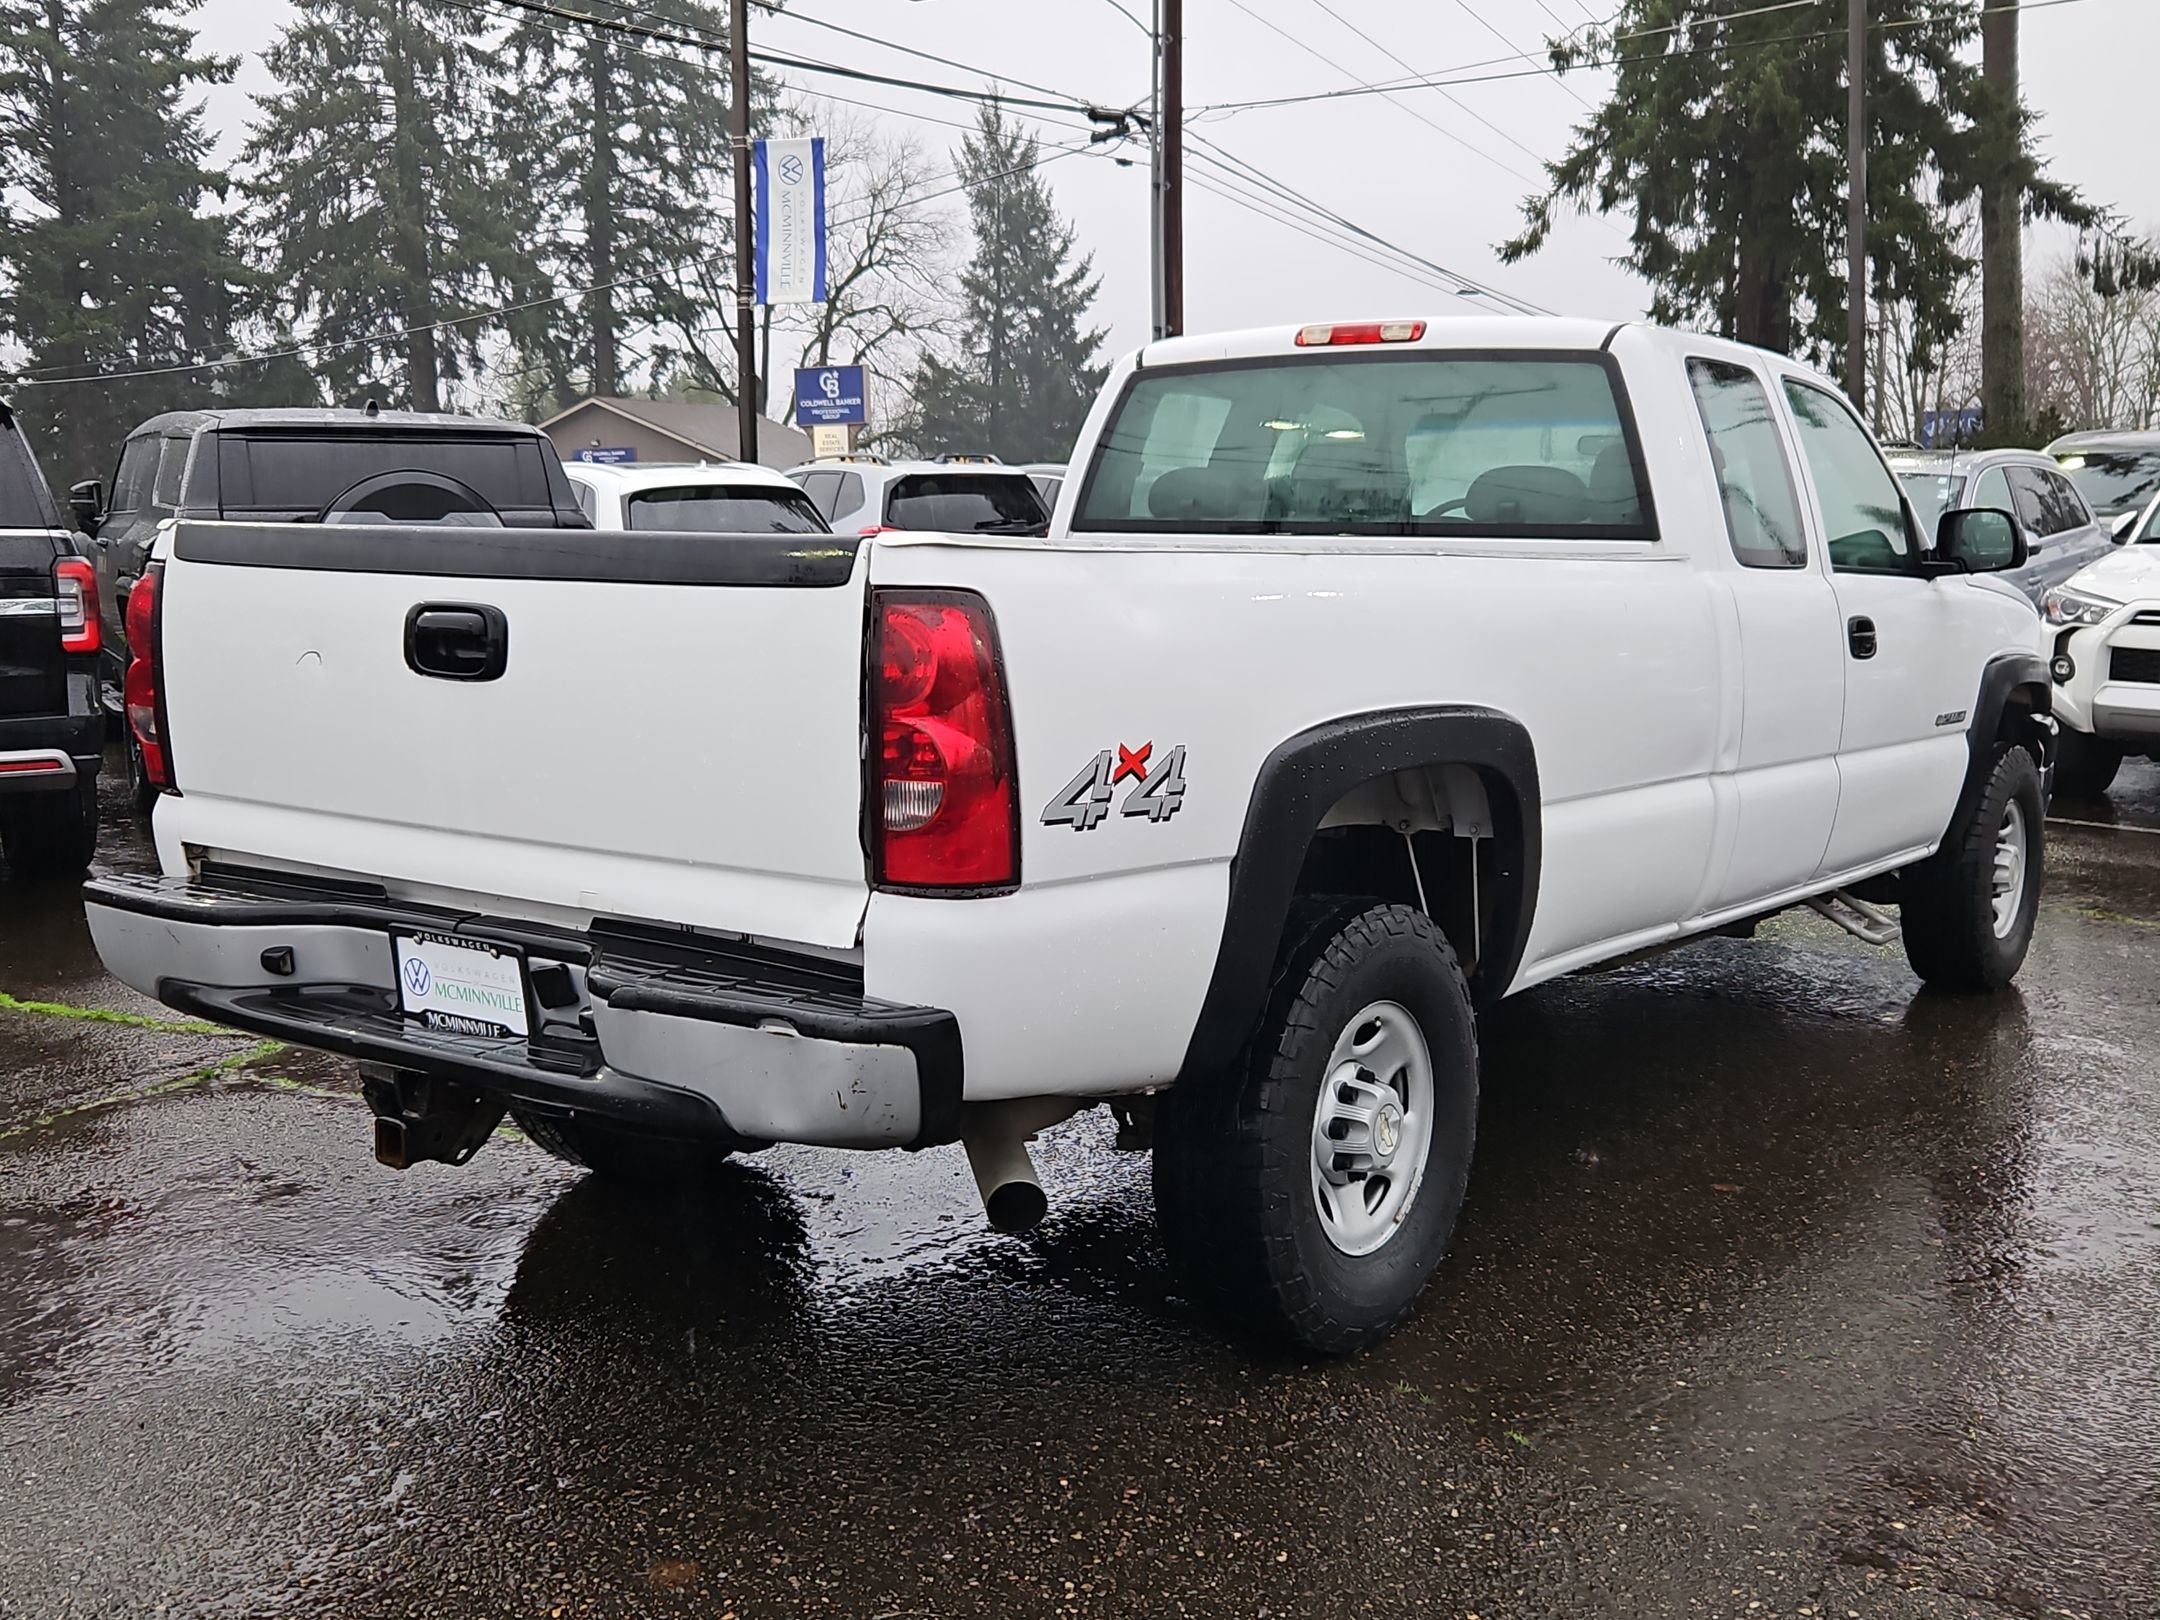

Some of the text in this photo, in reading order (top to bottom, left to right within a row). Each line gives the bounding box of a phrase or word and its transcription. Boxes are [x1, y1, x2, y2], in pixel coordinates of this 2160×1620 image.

[780, 190, 792, 289] MCMINNVILLE
[800, 398, 862, 407] COLDWELL BANKER
[417, 931, 490, 951] VOLKSWAGEN
[434, 963, 516, 984] VOLKSWAGEN
[434, 982, 523, 1013] MCMINNVILLE
[426, 1012, 501, 1038] MCMINNVILLE
